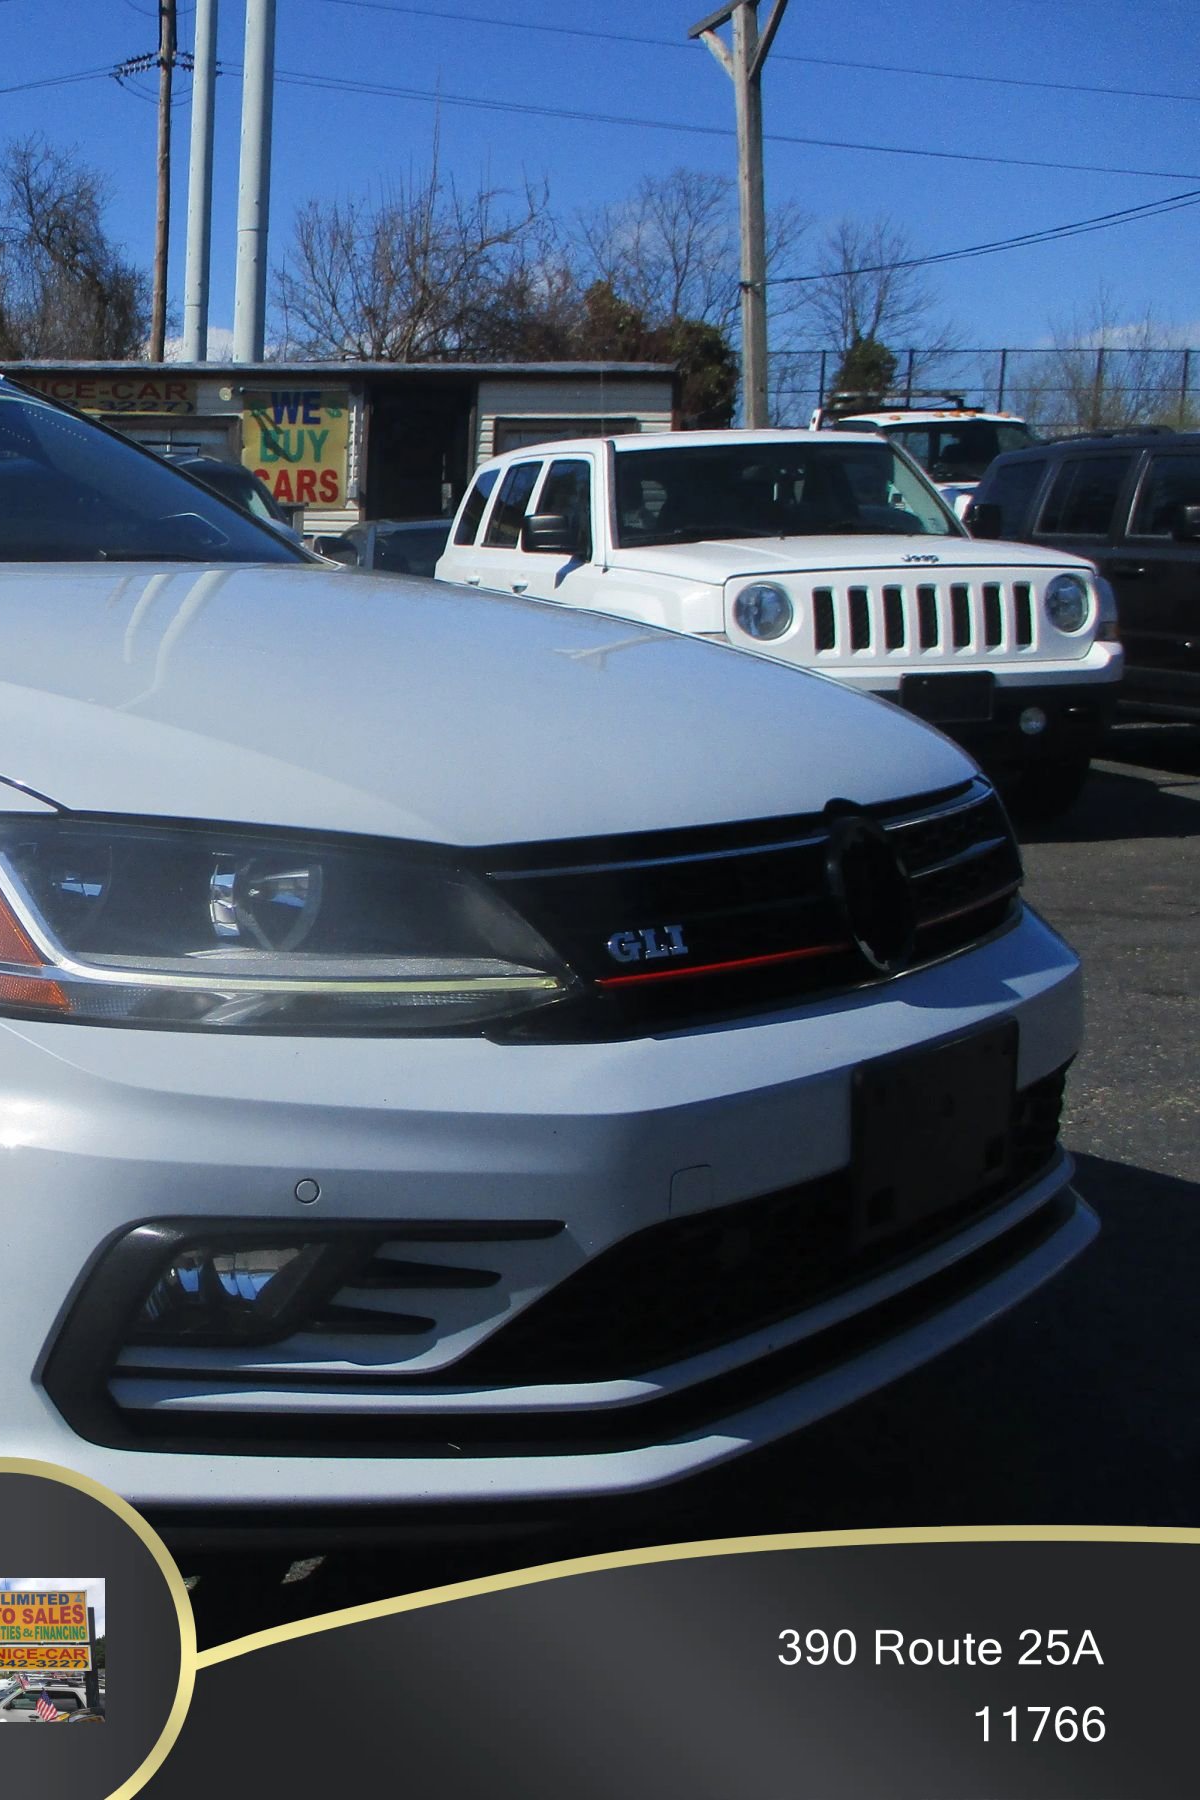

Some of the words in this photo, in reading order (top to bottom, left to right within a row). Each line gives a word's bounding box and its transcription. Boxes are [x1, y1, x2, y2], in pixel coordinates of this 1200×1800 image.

[272, 391, 321, 424] WE
[260, 429, 329, 463] BUY
[607, 925, 689, 963] GLI
